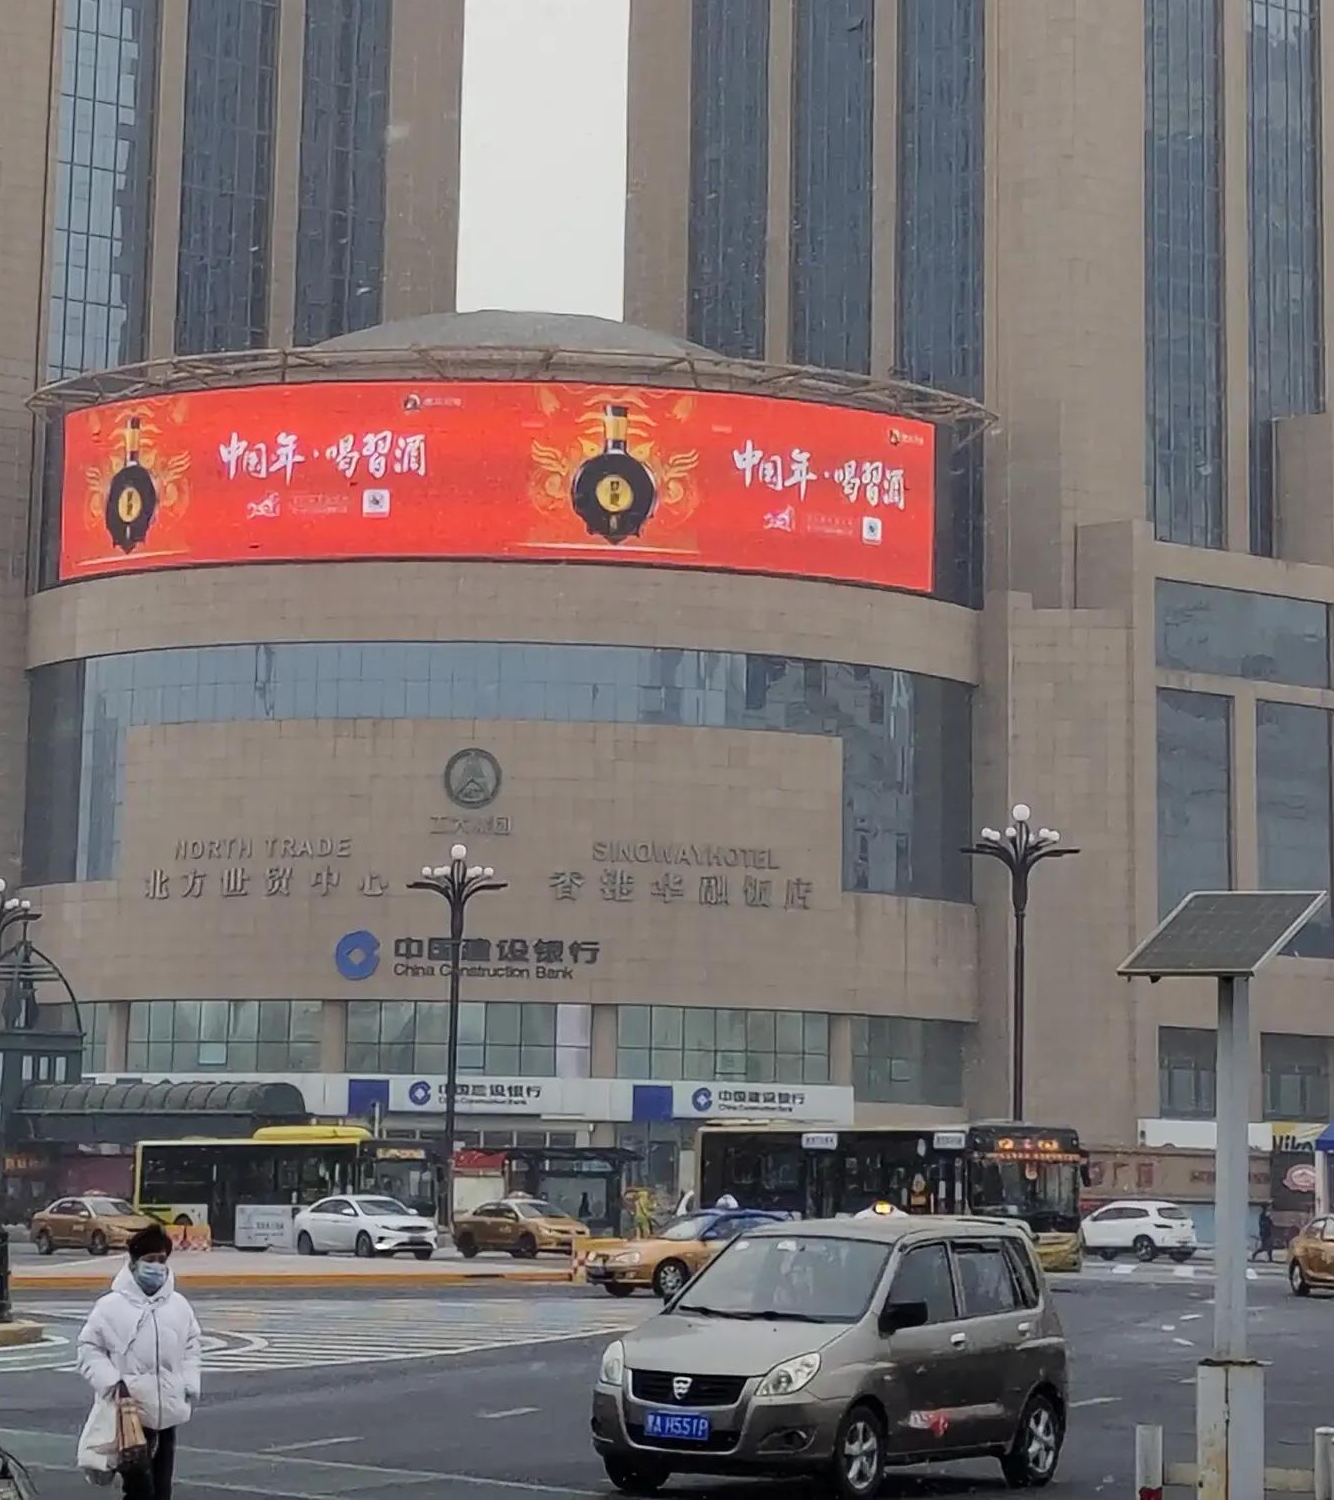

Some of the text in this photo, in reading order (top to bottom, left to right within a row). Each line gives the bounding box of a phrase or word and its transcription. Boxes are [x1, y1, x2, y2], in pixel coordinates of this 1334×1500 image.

[175, 836, 353, 860] NORTH TRADE
[144, 864, 390, 900] 北方世贸中心
[394, 963, 573, 980] China Cnstruction Bank
